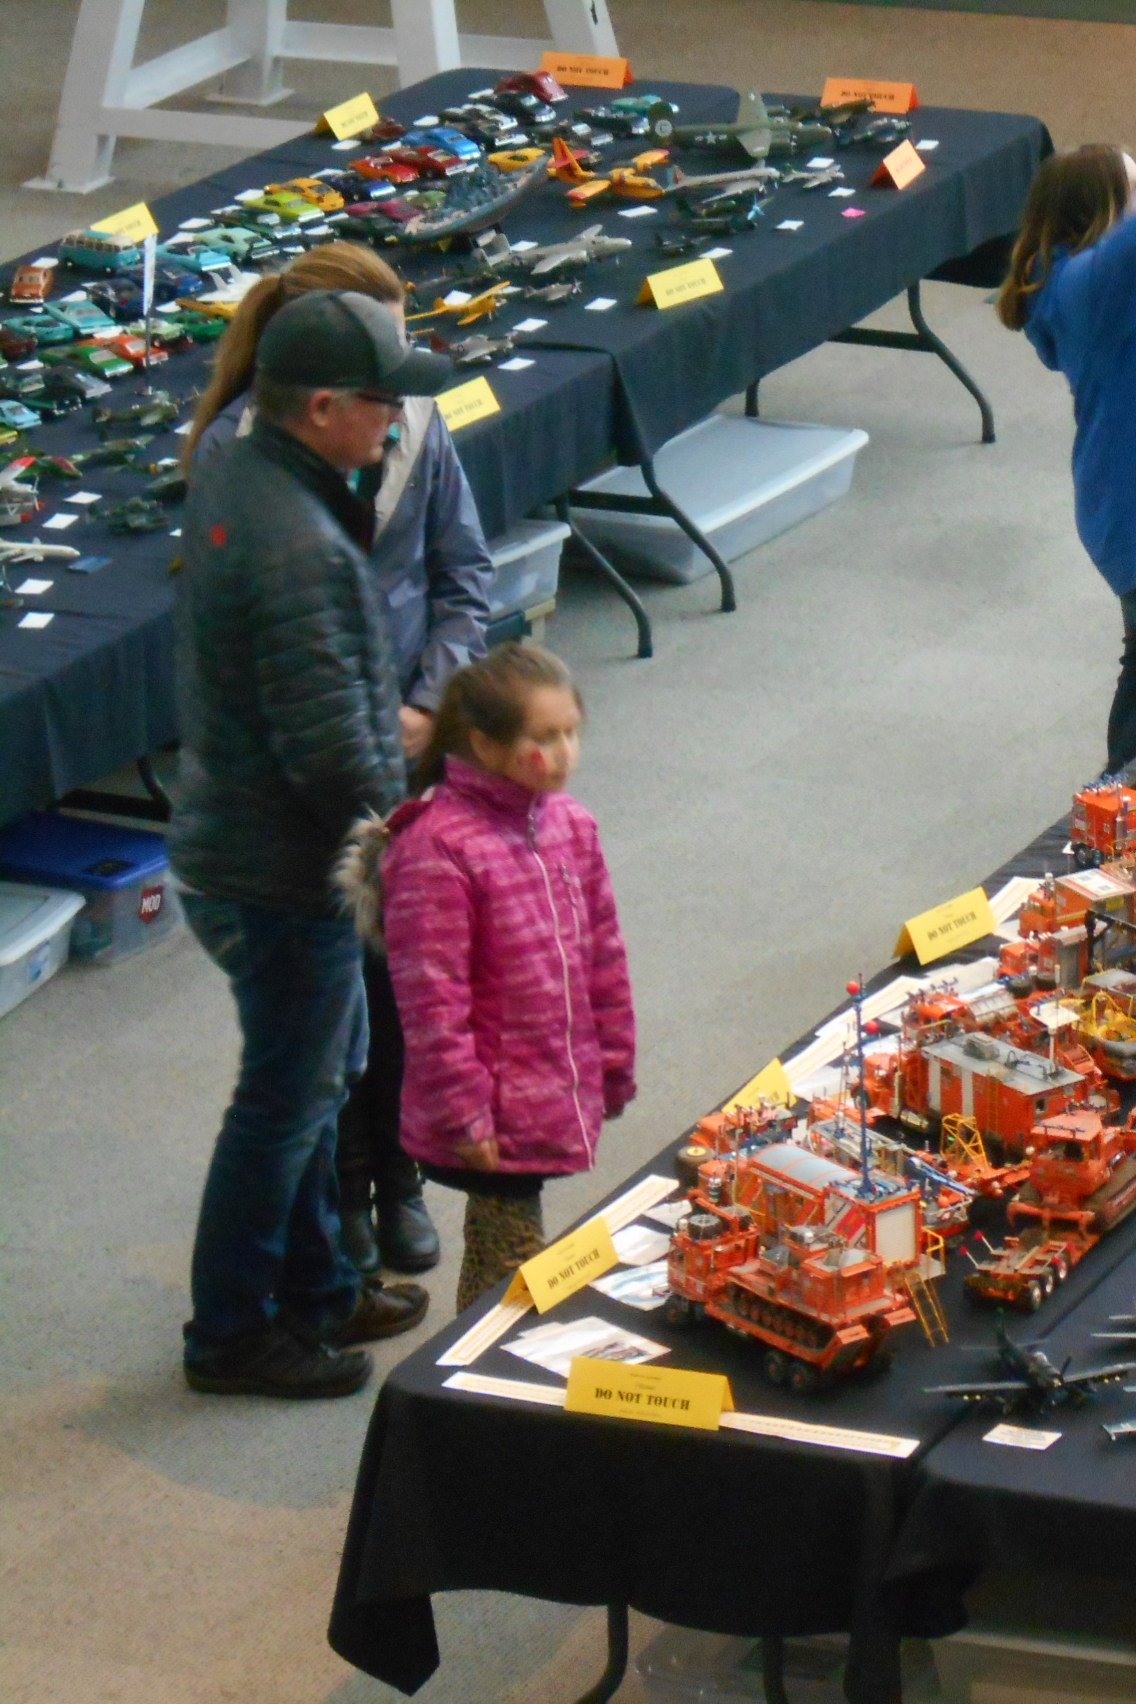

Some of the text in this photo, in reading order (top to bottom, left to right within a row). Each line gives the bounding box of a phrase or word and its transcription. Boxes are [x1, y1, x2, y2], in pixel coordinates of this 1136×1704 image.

[927, 911, 977, 940] DO NOT TOUCH
[547, 1276, 559, 1289] DO
[560, 1265, 575, 1282] NOT
[574, 1248, 600, 1274] TOUCH
[594, 1387, 691, 1412] DO NOT TOUCH
